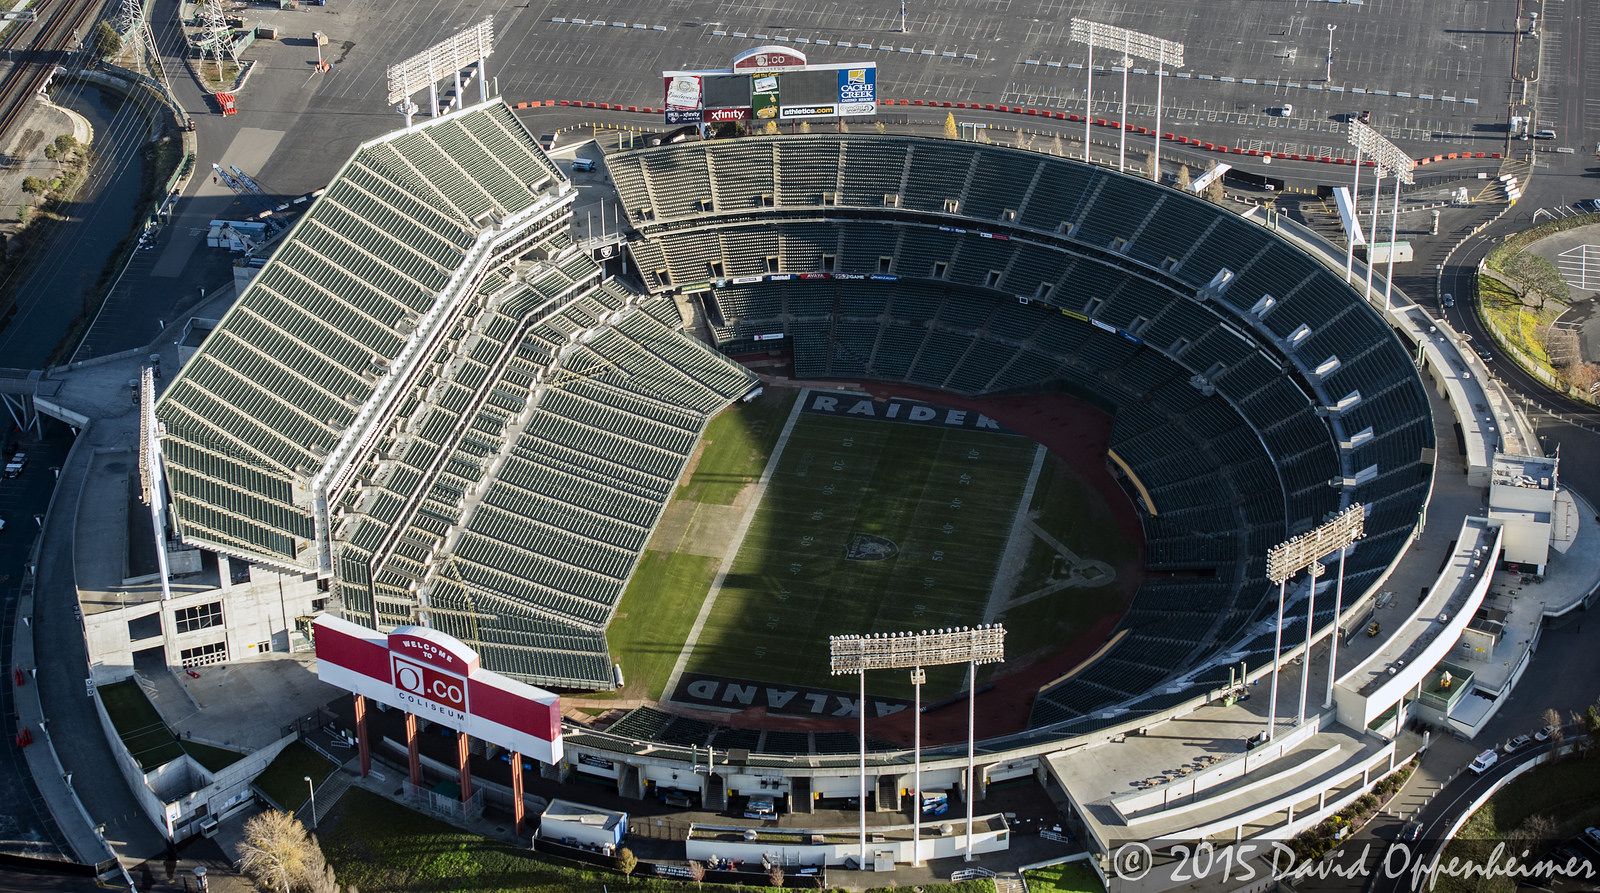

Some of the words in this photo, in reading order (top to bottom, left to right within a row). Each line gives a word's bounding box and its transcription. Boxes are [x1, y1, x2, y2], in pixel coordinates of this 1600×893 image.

[841, 83, 874, 91] CACHE
[841, 90, 873, 98] CREEK
[711, 109, 745, 121] xfinity
[784, 107, 833, 115] athletics.com
[403, 640, 453, 663] WELCOME
[423, 651, 433, 659] TO
[399, 692, 465, 721] COLISEUM
